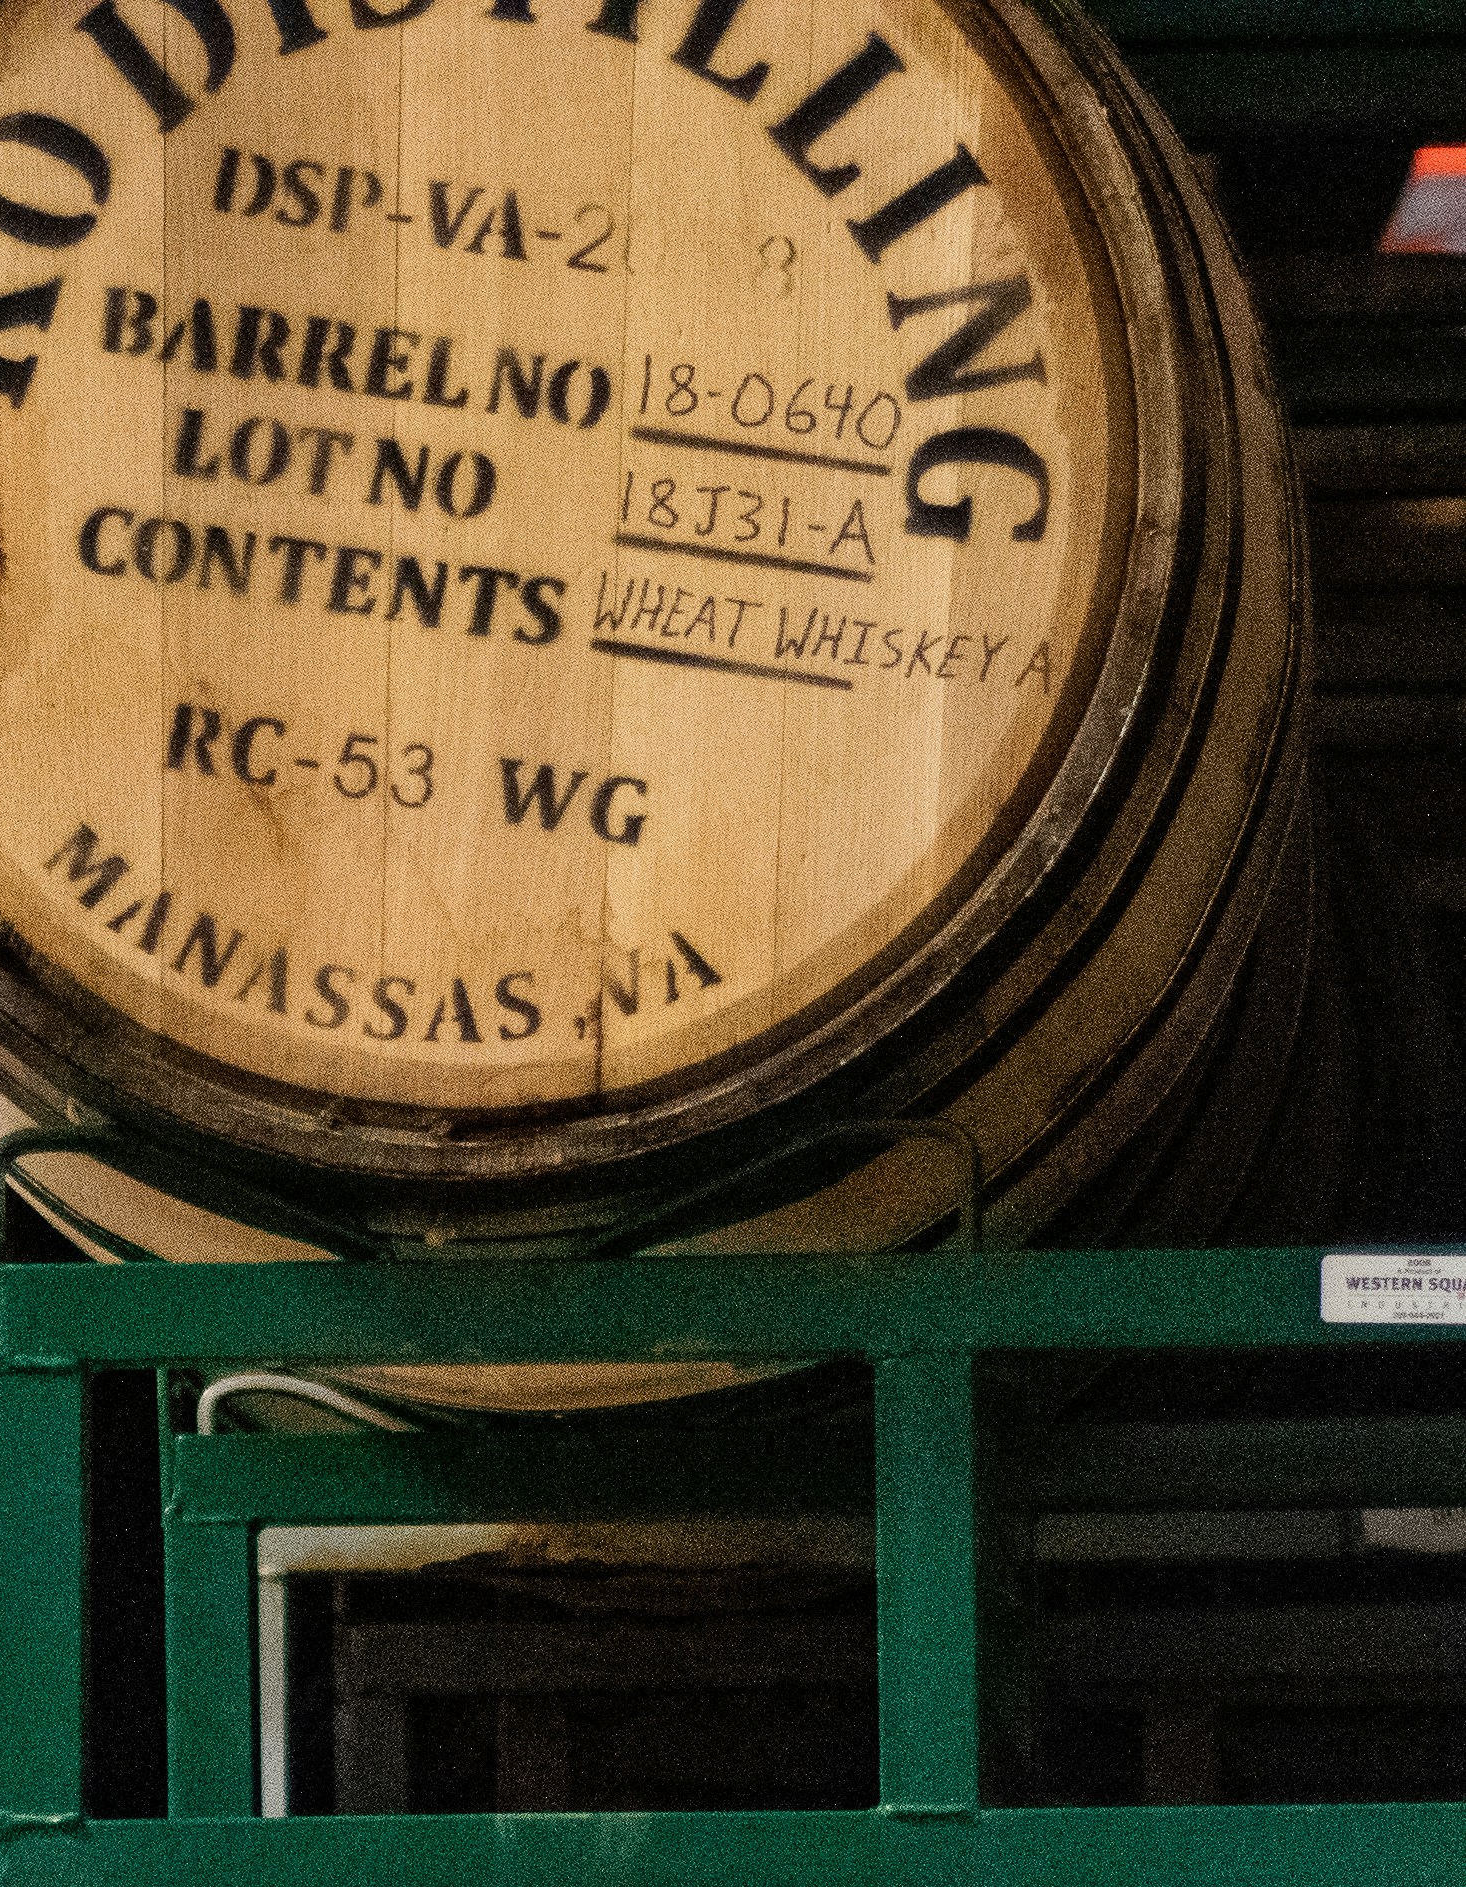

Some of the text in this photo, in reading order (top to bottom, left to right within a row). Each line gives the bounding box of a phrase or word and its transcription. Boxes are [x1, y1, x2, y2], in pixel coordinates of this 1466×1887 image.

[77, 0, 1053, 549] DLLING
[100, 286, 612, 432] BARREL NO
[636, 352, 903, 452] 18-0640
[172, 408, 498, 522] LOT NO
[621, 469, 878, 566] 18J31-A
[77, 505, 568, 648] CONTENTS
[593, 570, 1053, 694] WHEAT WHISKEY A
[164, 701, 650, 848] RC-53 WG
[1346, 1277, 1423, 1291] WESTERN
